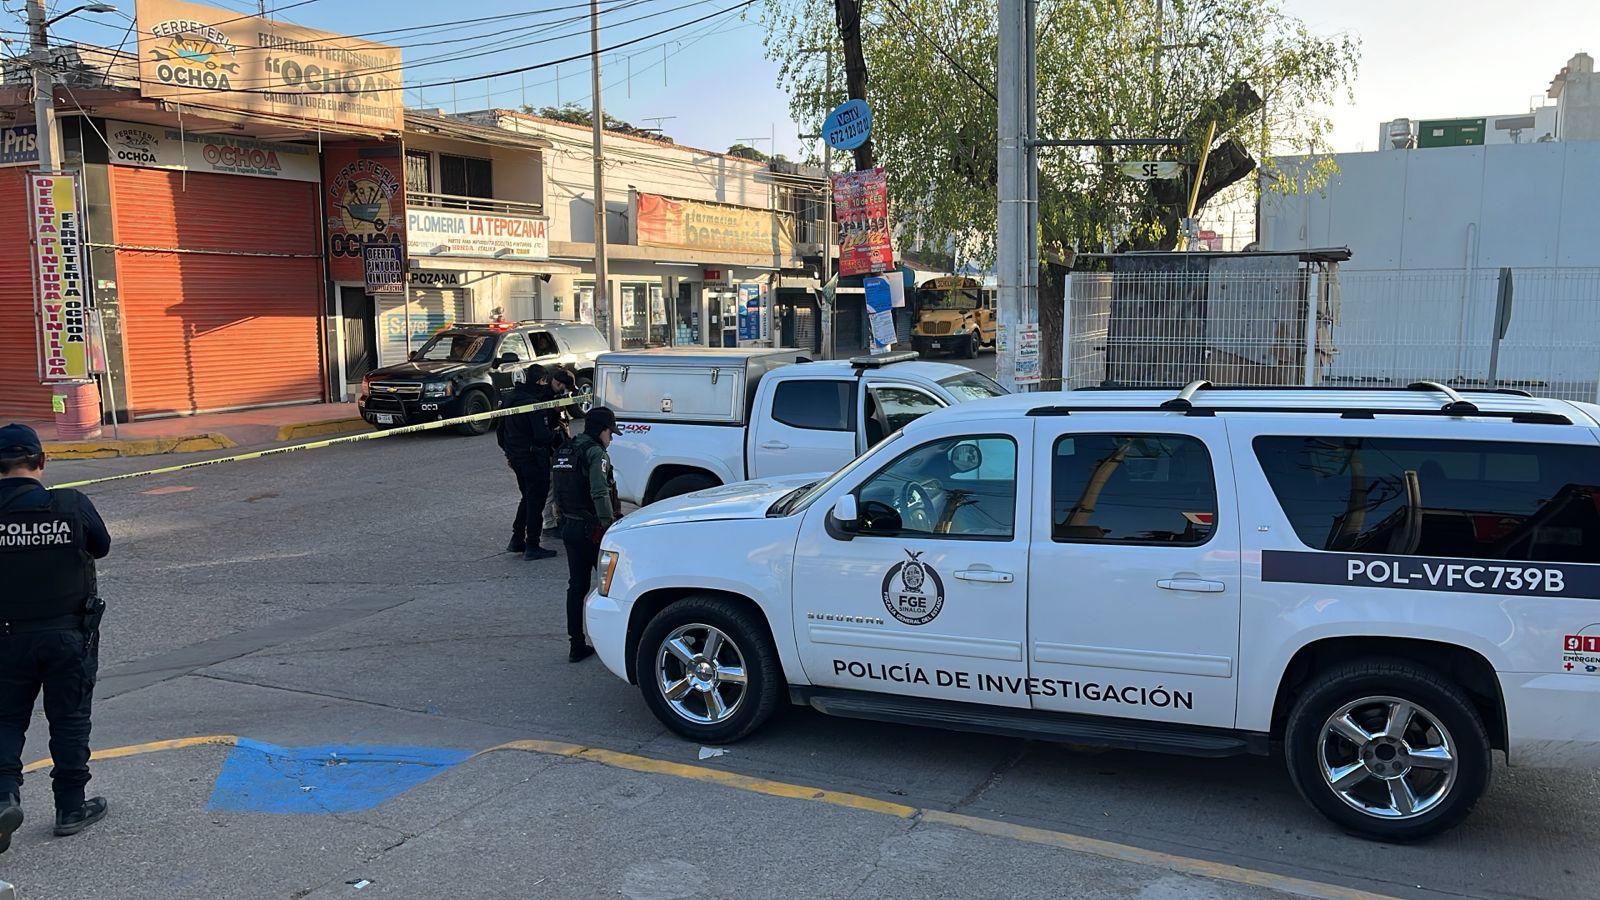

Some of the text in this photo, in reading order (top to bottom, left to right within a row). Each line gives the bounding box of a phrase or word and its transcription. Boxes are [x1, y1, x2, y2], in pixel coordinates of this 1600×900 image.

[152, 21, 237, 56] FERRETERIA
[258, 32, 316, 58] FERRETERIA
[157, 64, 231, 90] OCHOA
[4, 128, 39, 154] Pris
[114, 129, 159, 146] FERRETERIA
[830, 130, 845, 145] 672
[845, 124, 857, 139] 123
[117, 150, 157, 163] OCHOA
[202, 144, 282, 170] OCHOA
[330, 159, 401, 198] FERRETERIA
[1142, 163, 1158, 177] SE
[409, 214, 545, 239] PLOMERIA LA TEPOZANA
[367, 248, 396, 260] OFERTA
[367, 260, 401, 272] PINTURA
[36, 179, 66, 375] OFERTA PINTURA VINILICA
[61, 212, 83, 343] FERRETERIA OCHOA
[367, 272, 402, 284] VINILICA
[410, 273, 457, 285] POZANA
[0, 520, 71, 535] POLICÍA
[0, 533, 71, 546] MUNICIPAL
[1348, 559, 1565, 592] POL-VFC739B
[899, 595, 927, 608] FGE
[899, 606, 927, 614] SINALOA
[807, 611, 885, 625] SUBURBAN
[896, 613, 921, 624] GENERAL
[833, 659, 1194, 710] POLICÍA DE INVESTIGACIÓN
